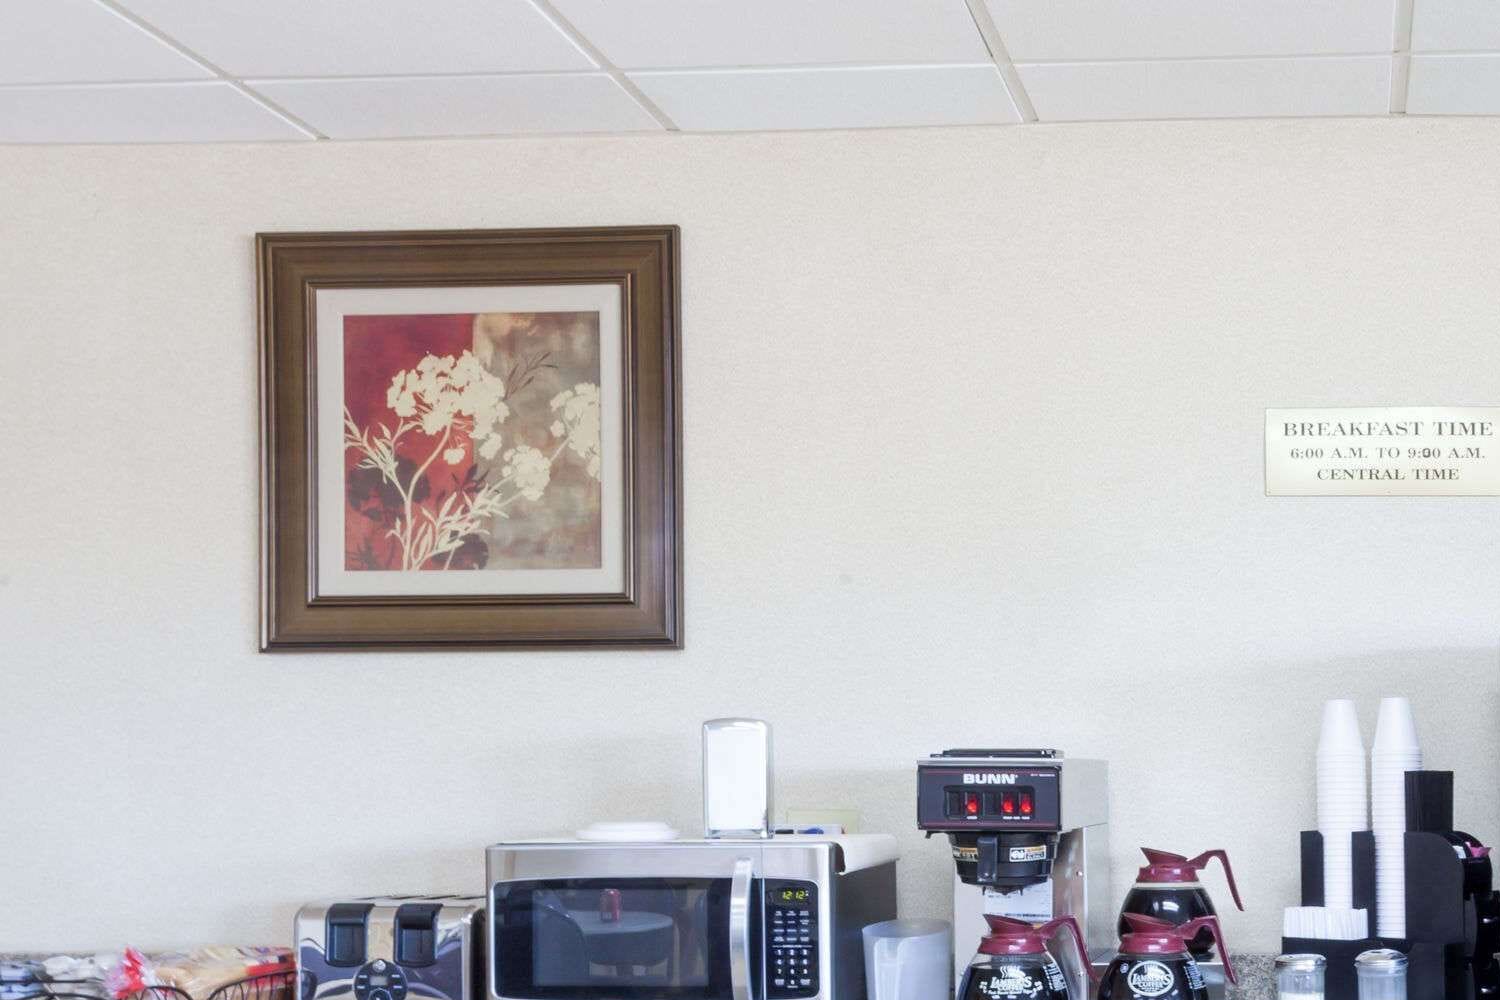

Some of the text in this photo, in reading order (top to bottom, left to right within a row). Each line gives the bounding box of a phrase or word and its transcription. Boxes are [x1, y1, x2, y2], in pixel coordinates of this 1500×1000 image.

[1283, 421, 1493, 437] BREAKFAST TIME
[1290, 447, 1324, 459] 6:00
[1331, 447, 1368, 459] A.M.
[1376, 447, 1400, 459] TO
[1448, 447, 1486, 459] A.M.
[1316, 468, 1460, 481] CENTRAL TIME
[962, 773, 1015, 784] BUNN
